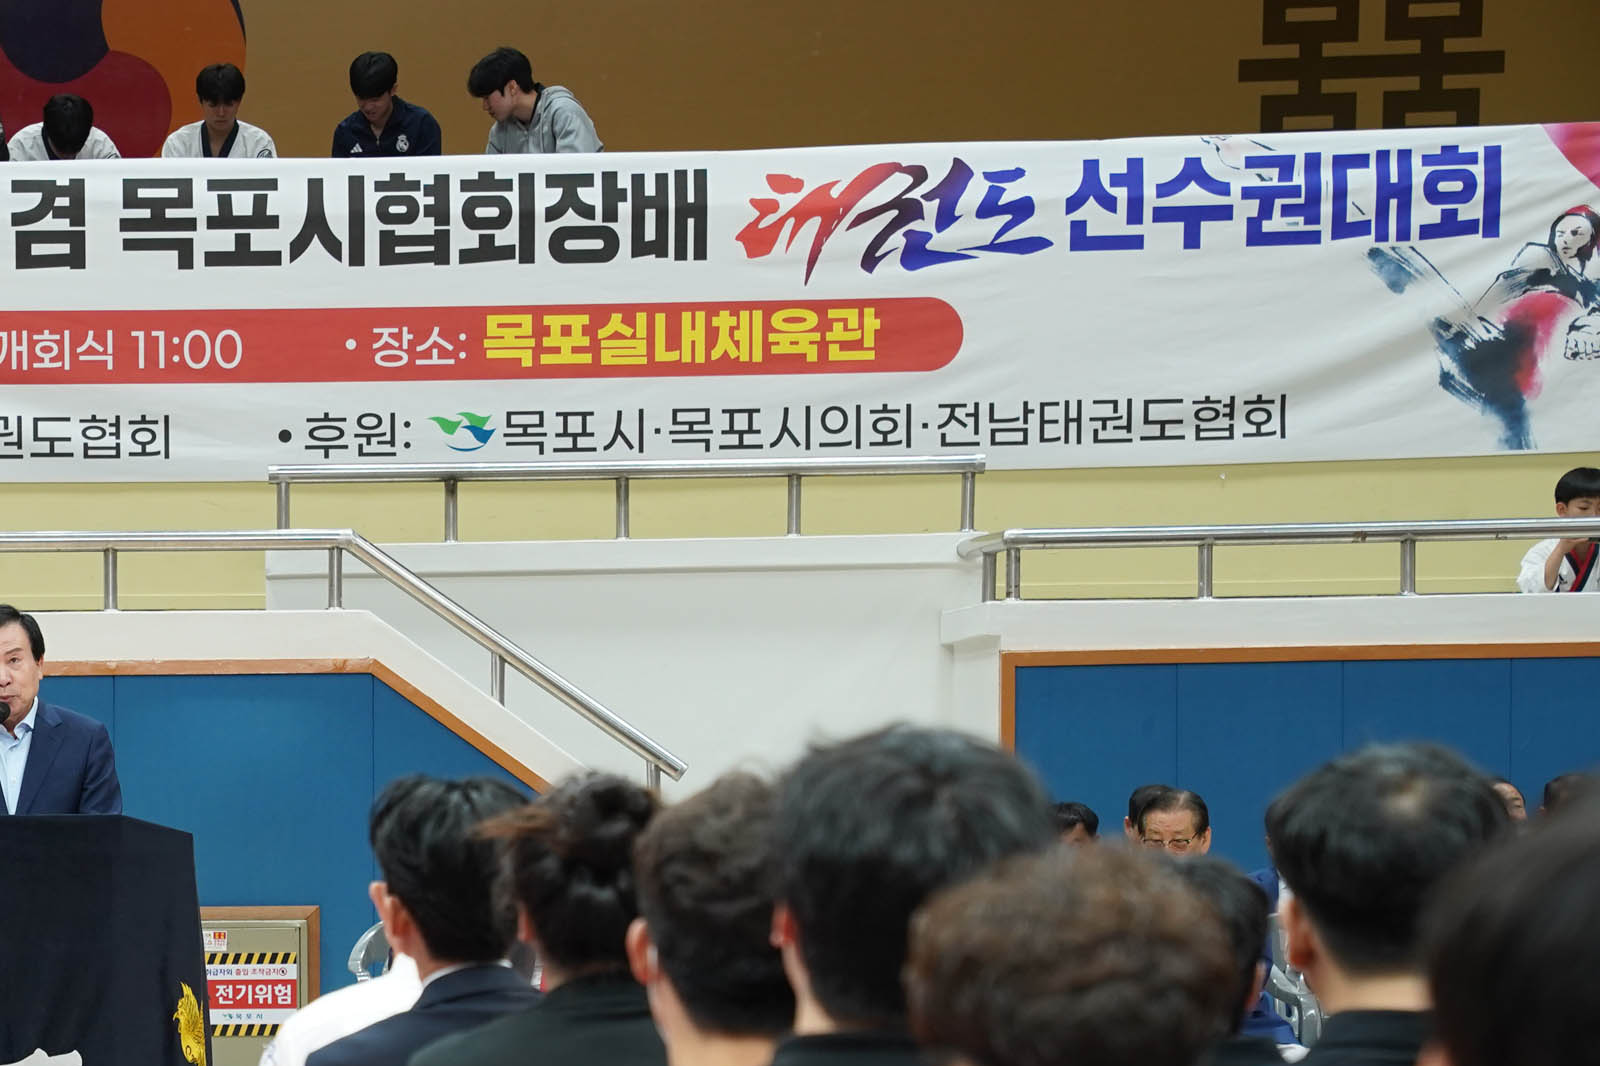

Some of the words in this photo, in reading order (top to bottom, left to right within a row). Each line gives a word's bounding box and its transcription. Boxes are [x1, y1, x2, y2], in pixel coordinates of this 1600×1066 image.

[10, 178, 86, 270] 겸
[118, 168, 707, 270] 목포시협회장배
[735, 157, 1054, 287] 태권도
[1064, 145, 1502, 253] 선수권대회
[130, 329, 243, 370] 11:00
[483, 306, 881, 369] 목포실내체육관
[215, 983, 292, 1006] 전기위험
